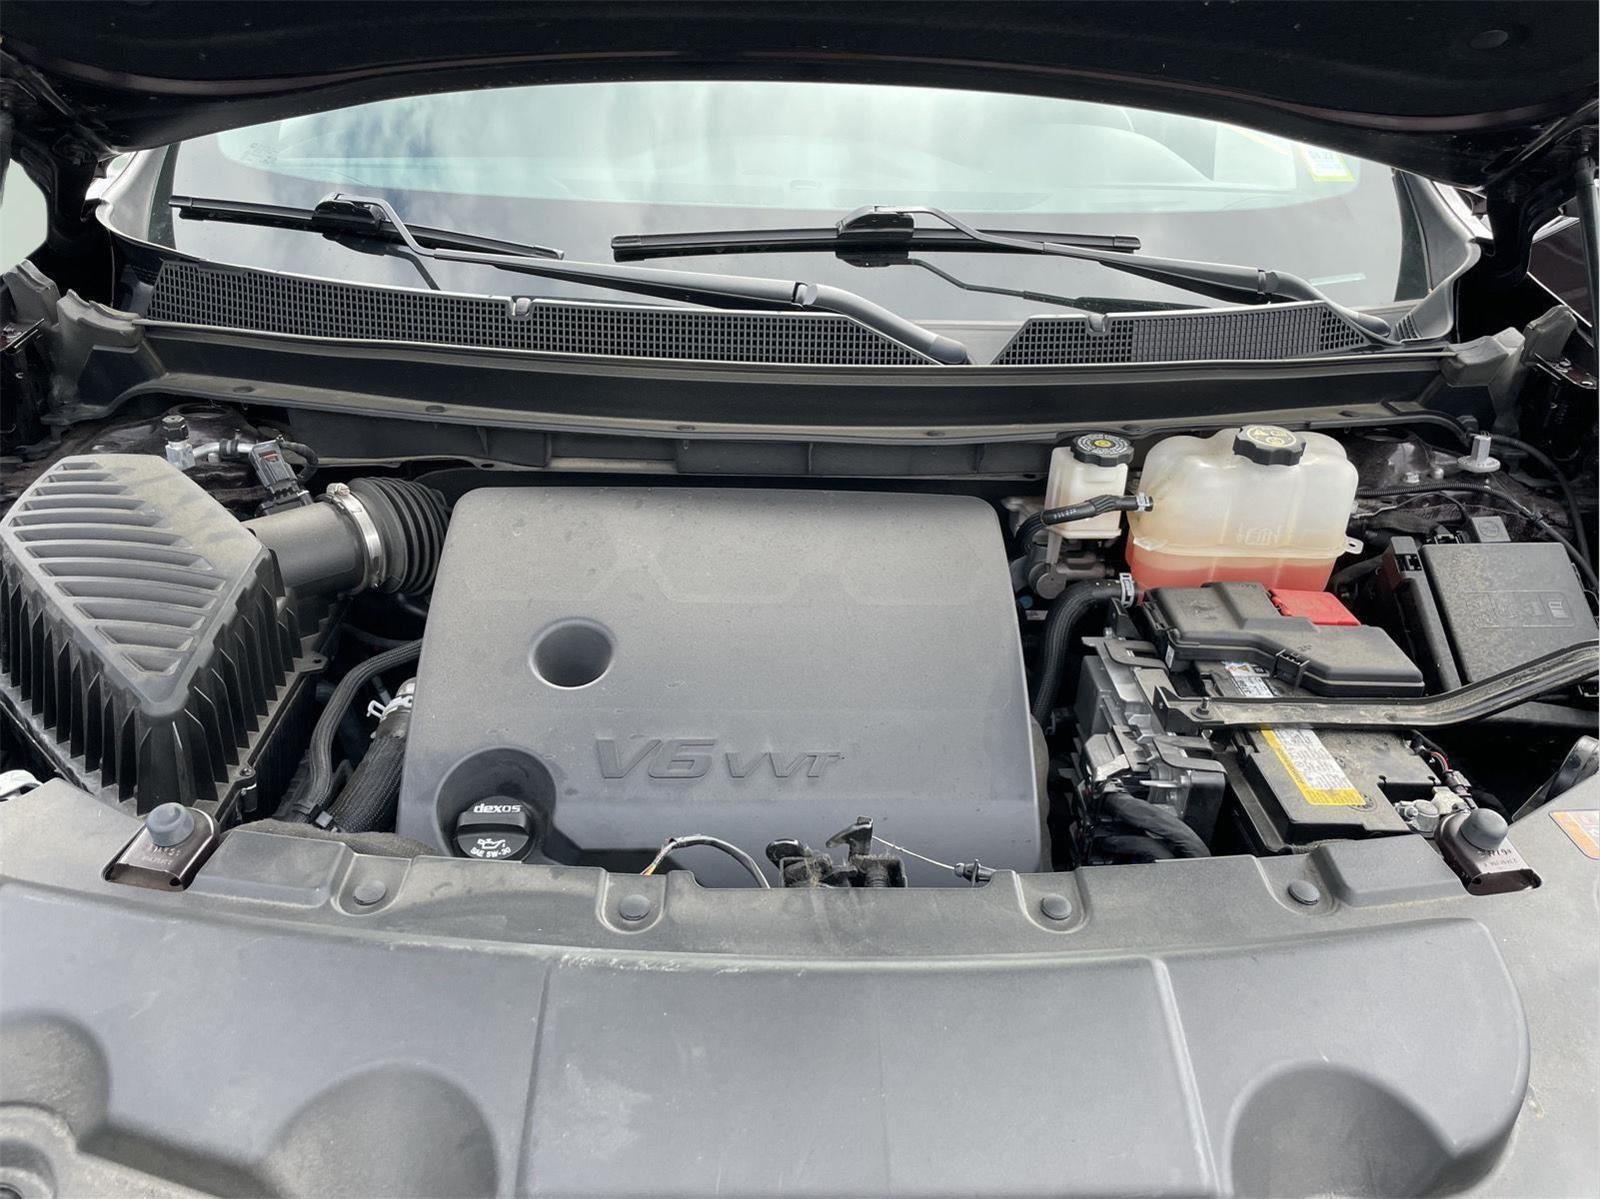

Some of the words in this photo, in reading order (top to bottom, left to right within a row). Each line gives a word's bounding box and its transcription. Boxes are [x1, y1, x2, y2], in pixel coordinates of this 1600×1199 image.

[595, 737, 717, 780] V6
[725, 751, 845, 779] VVT
[473, 803, 523, 814] dexos
[470, 846, 485, 858] SAE
